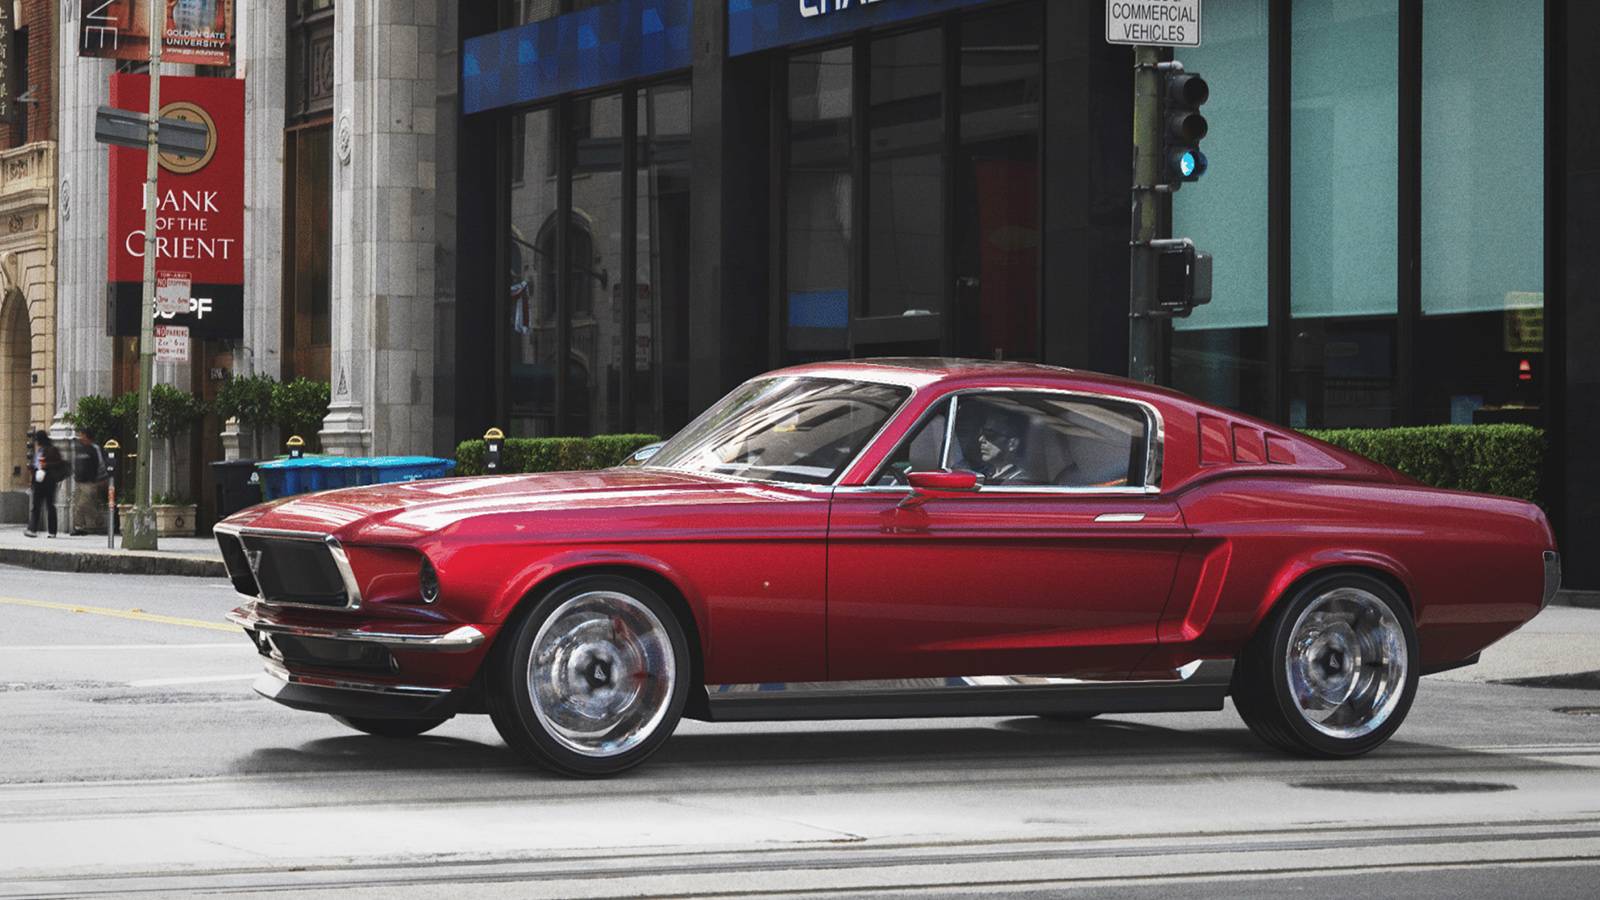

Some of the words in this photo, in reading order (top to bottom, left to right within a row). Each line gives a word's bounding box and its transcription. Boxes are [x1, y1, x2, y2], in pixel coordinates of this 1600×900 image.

[1112, 3, 1196, 22] COMMERCIAL
[166, 29, 201, 38] GOLDEN
[204, 31, 225, 39] GATE
[1123, 24, 1185, 41] VEHICLES
[166, 39, 225, 48] UNIVERSITY
[155, 217, 175, 230] OF
[178, 218, 208, 231] THE
[126, 230, 235, 259] ORIENT
[158, 279, 167, 287] NO
[156, 327, 166, 336] NO
